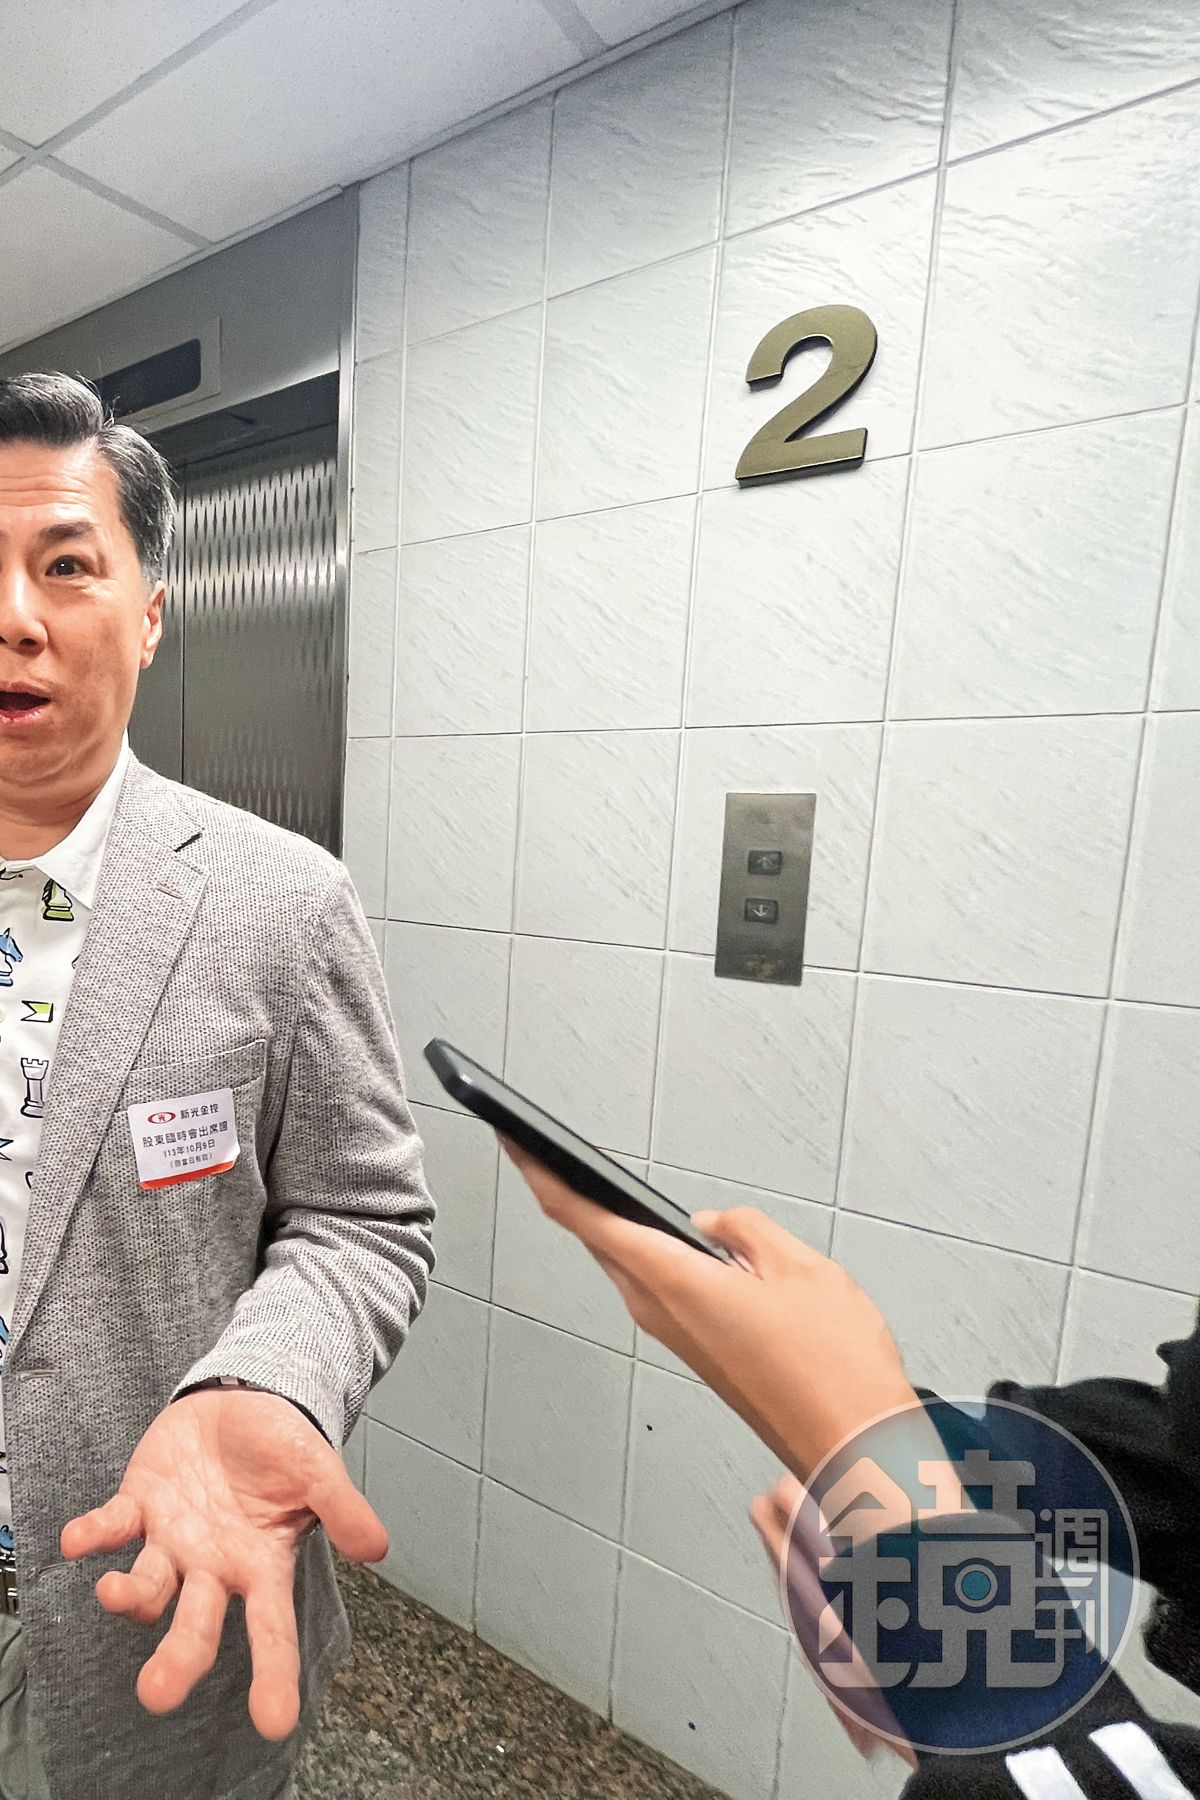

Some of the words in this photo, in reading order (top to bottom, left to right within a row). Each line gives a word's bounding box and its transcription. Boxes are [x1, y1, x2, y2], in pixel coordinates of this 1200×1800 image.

[735, 304, 878, 489] 2
[180, 1103, 219, 1120] 新光金控
